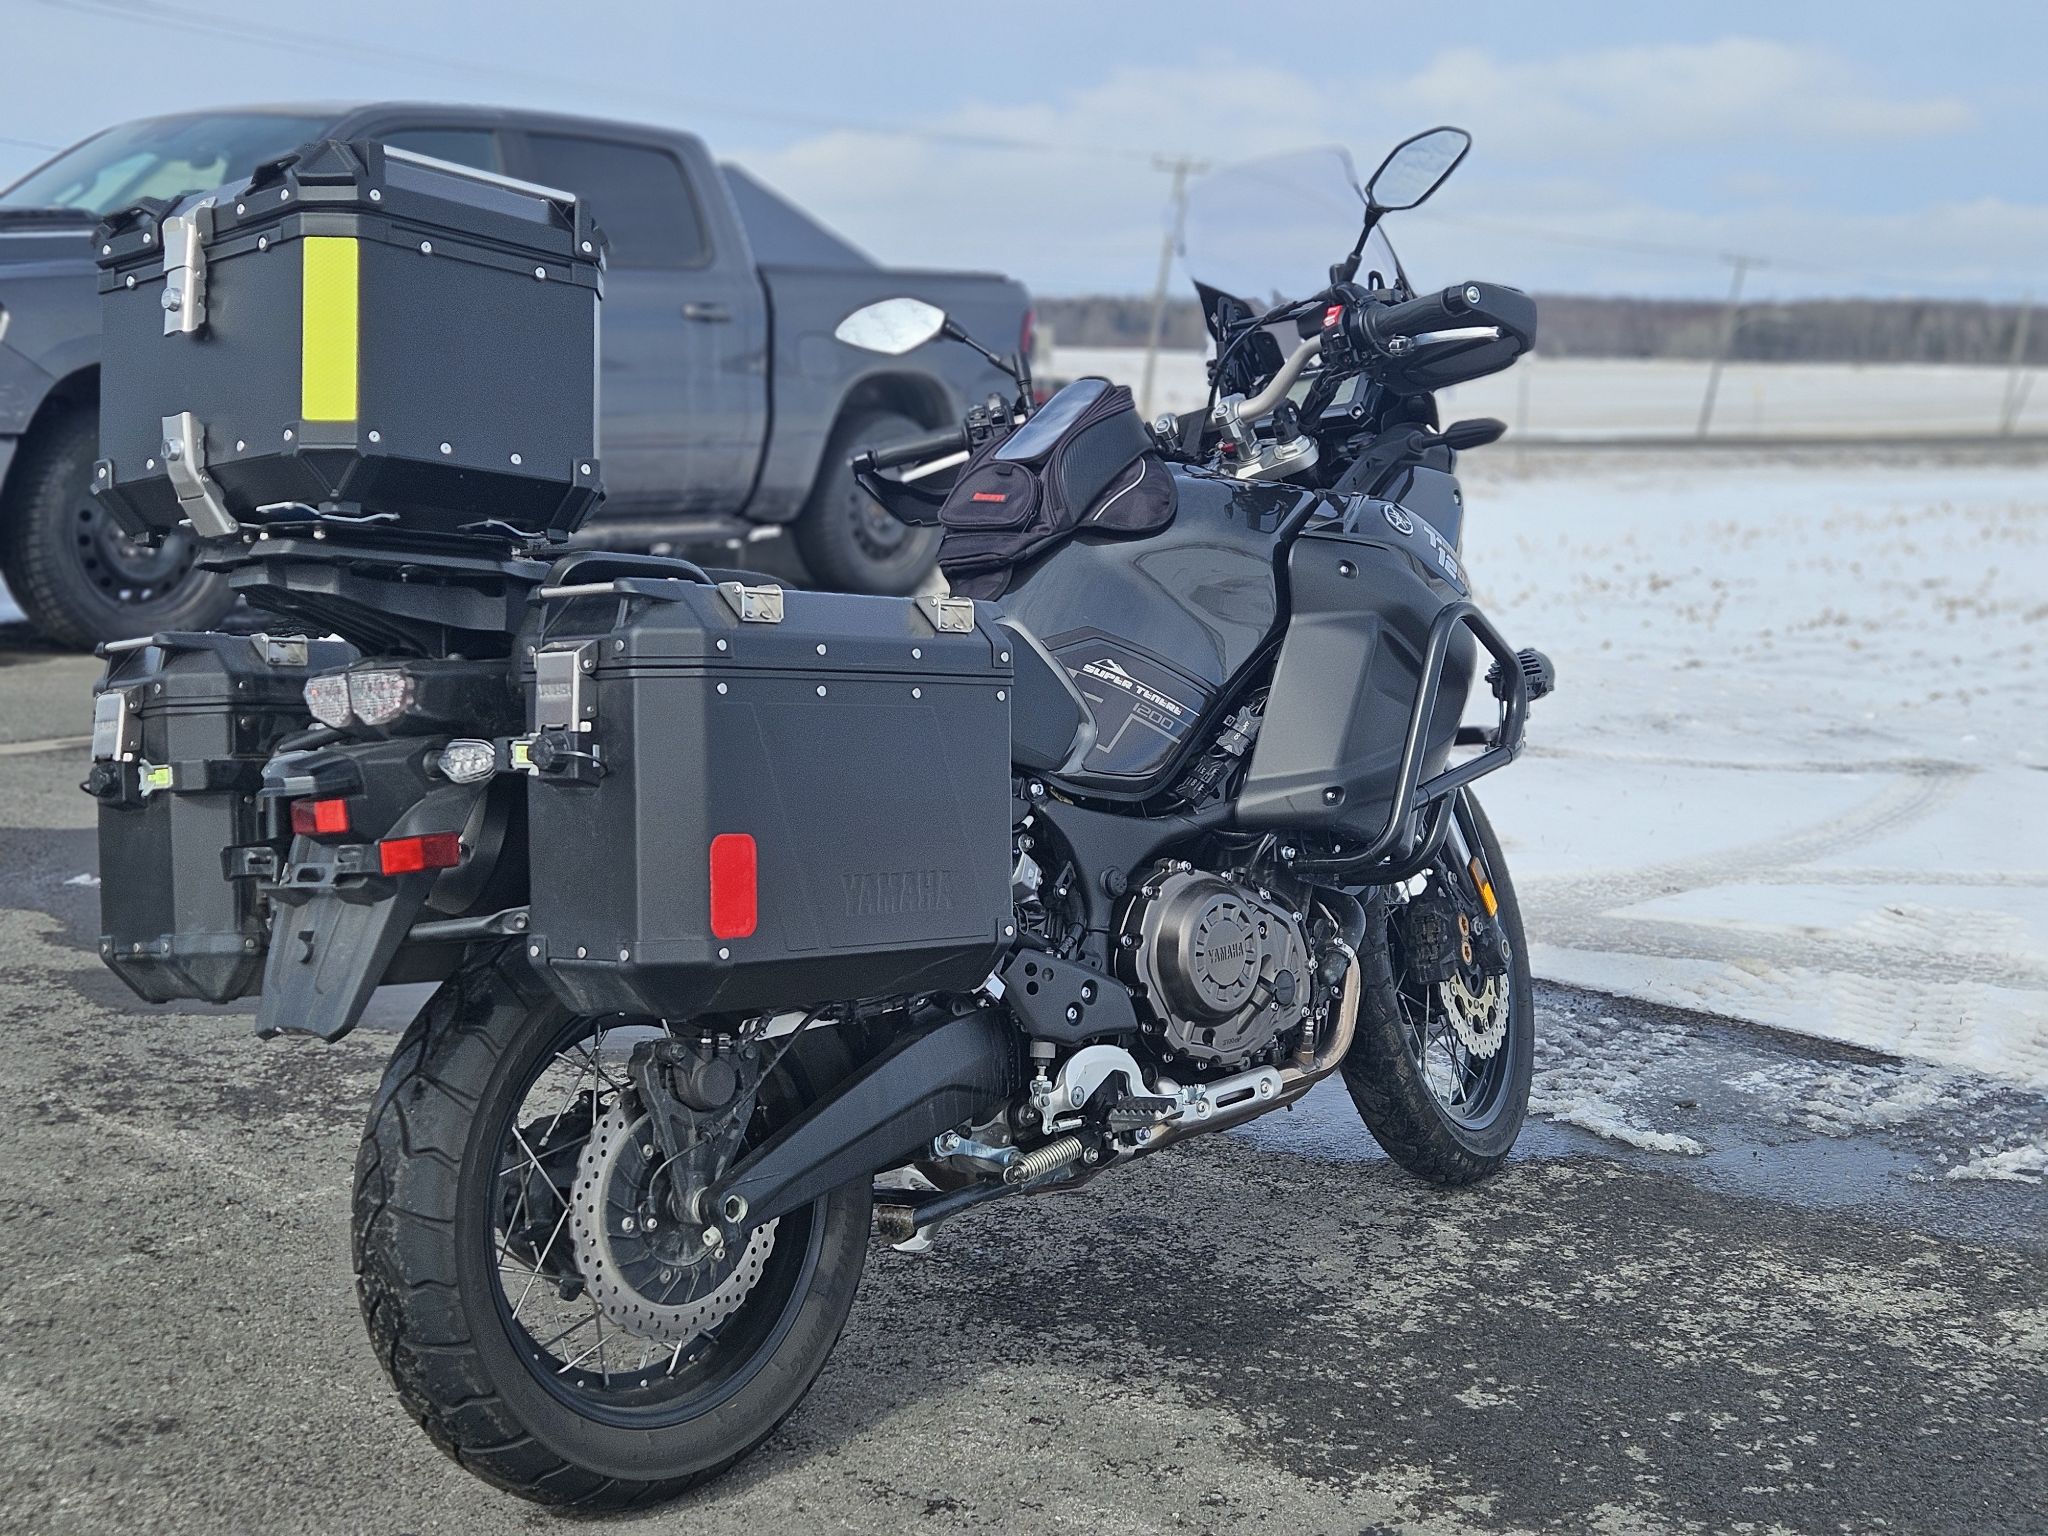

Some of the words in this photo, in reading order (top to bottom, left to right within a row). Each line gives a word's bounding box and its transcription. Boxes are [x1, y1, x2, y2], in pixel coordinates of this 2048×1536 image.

[1082, 663, 1133, 690] SUPER
[1132, 702, 1175, 730] 1200
[842, 870, 953, 915] YAMAHA
[1208, 942, 1244, 964] YAMAHA
